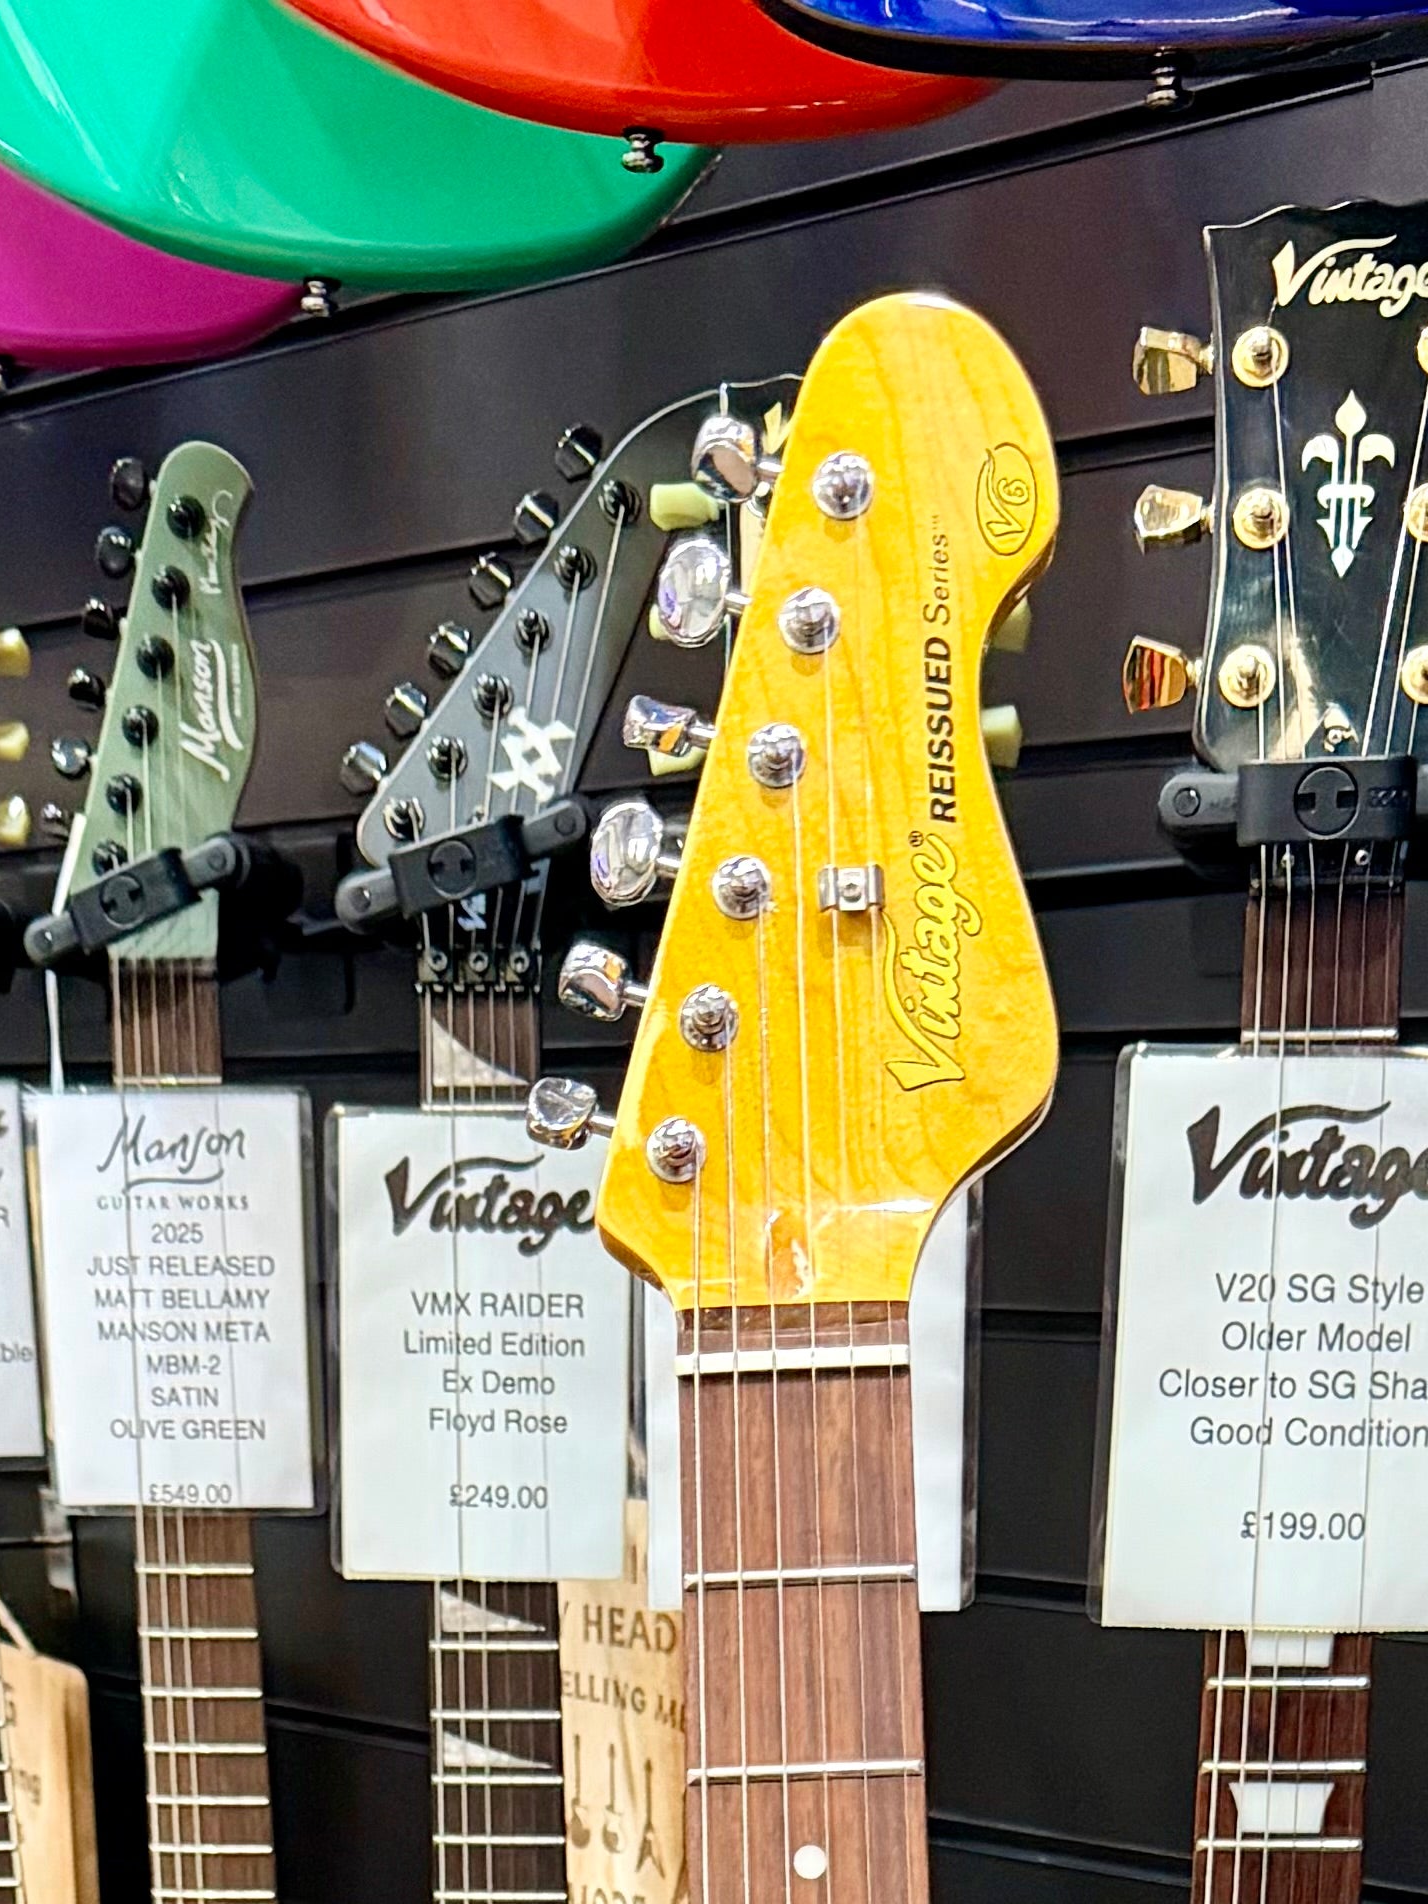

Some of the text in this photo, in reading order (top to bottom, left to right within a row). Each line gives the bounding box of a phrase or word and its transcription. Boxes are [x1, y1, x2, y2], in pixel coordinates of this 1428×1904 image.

[180, 639, 230, 782] Manson
[925, 637, 956, 823] REISSUED
[881, 835, 981, 1090] Vintage
[97, 1115, 245, 1180] Manson
[97, 1196, 248, 1211] GUITAR WORKS
[384, 1154, 595, 1256] Vintage
[151, 1225, 203, 1244] 2025
[87, 1256, 275, 1277] JUST RELEASED
[94, 1289, 269, 1310] MATT BELLAMY
[411, 1292, 584, 1318] VMX RAIDER
[1216, 1273, 1424, 1311] V20 SG Style
[98, 1322, 270, 1342] MANSON META
[403, 1332, 585, 1356] Limited Edition
[1222, 1322, 1411, 1352] Older Model
[147, 1355, 220, 1375] MBM-2
[442, 1371, 555, 1394] Ex Demo
[1159, 1370, 1258, 1398] Closer
[1269, 1372, 1297, 1399] to
[1308, 1371, 1356, 1399] SG
[151, 1387, 219, 1406] SATIN
[110, 1419, 265, 1440] OLIVE GREEN
[429, 1408, 568, 1438] Floyd Rose
[1190, 1417, 1272, 1446] Good
[149, 1483, 232, 1504] £549.00
[450, 1485, 547, 1509] £249.00
[1241, 1512, 1365, 1541] £199.00
[584, 1603, 677, 1654] HEAD
